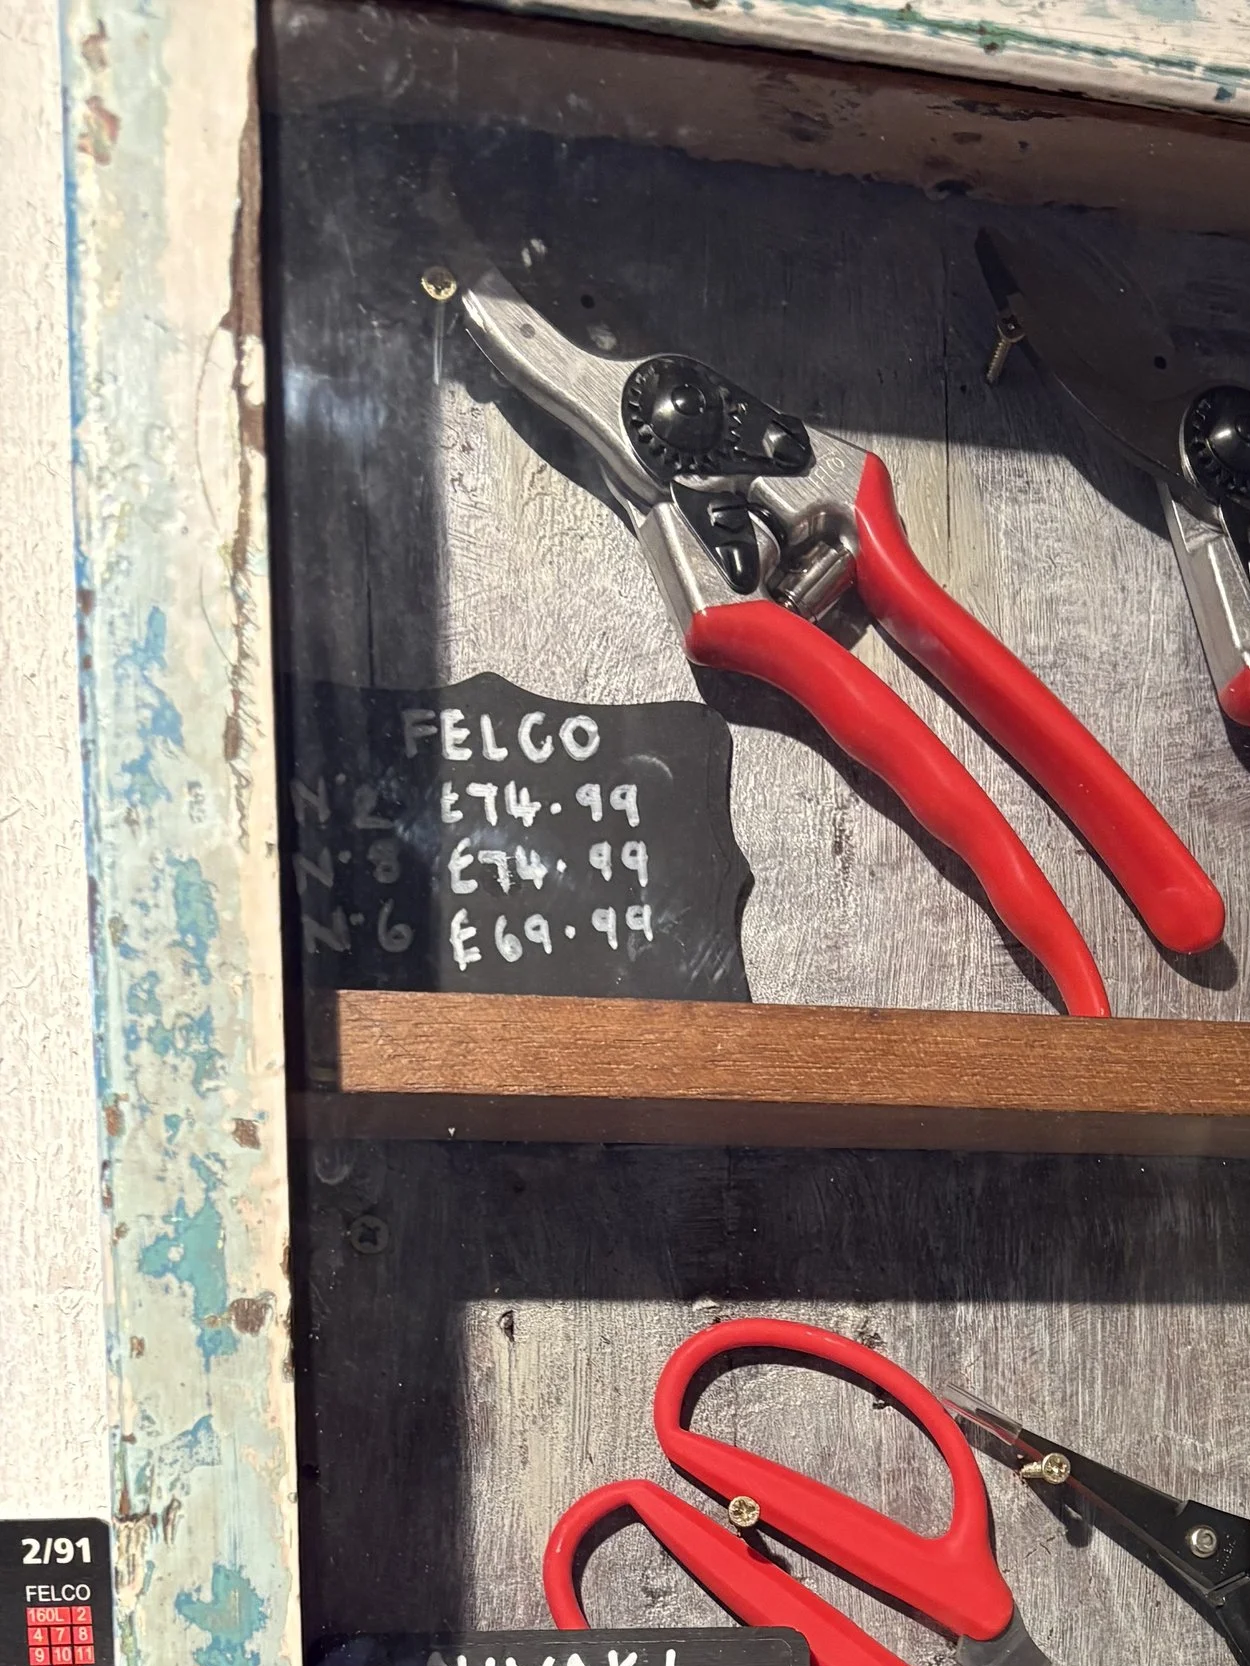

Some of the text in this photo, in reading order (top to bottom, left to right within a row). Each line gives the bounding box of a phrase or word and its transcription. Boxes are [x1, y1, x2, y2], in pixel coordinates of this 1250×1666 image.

[401, 708, 600, 761] FELCO
[21, 1537, 91, 1565] 2/91
[25, 1584, 91, 1602] FELCO
[28, 1607, 87, 1623] 160L 2
[33, 1627, 88, 1643] 4 7 8
[34, 1647, 93, 1663] 9 10 11
